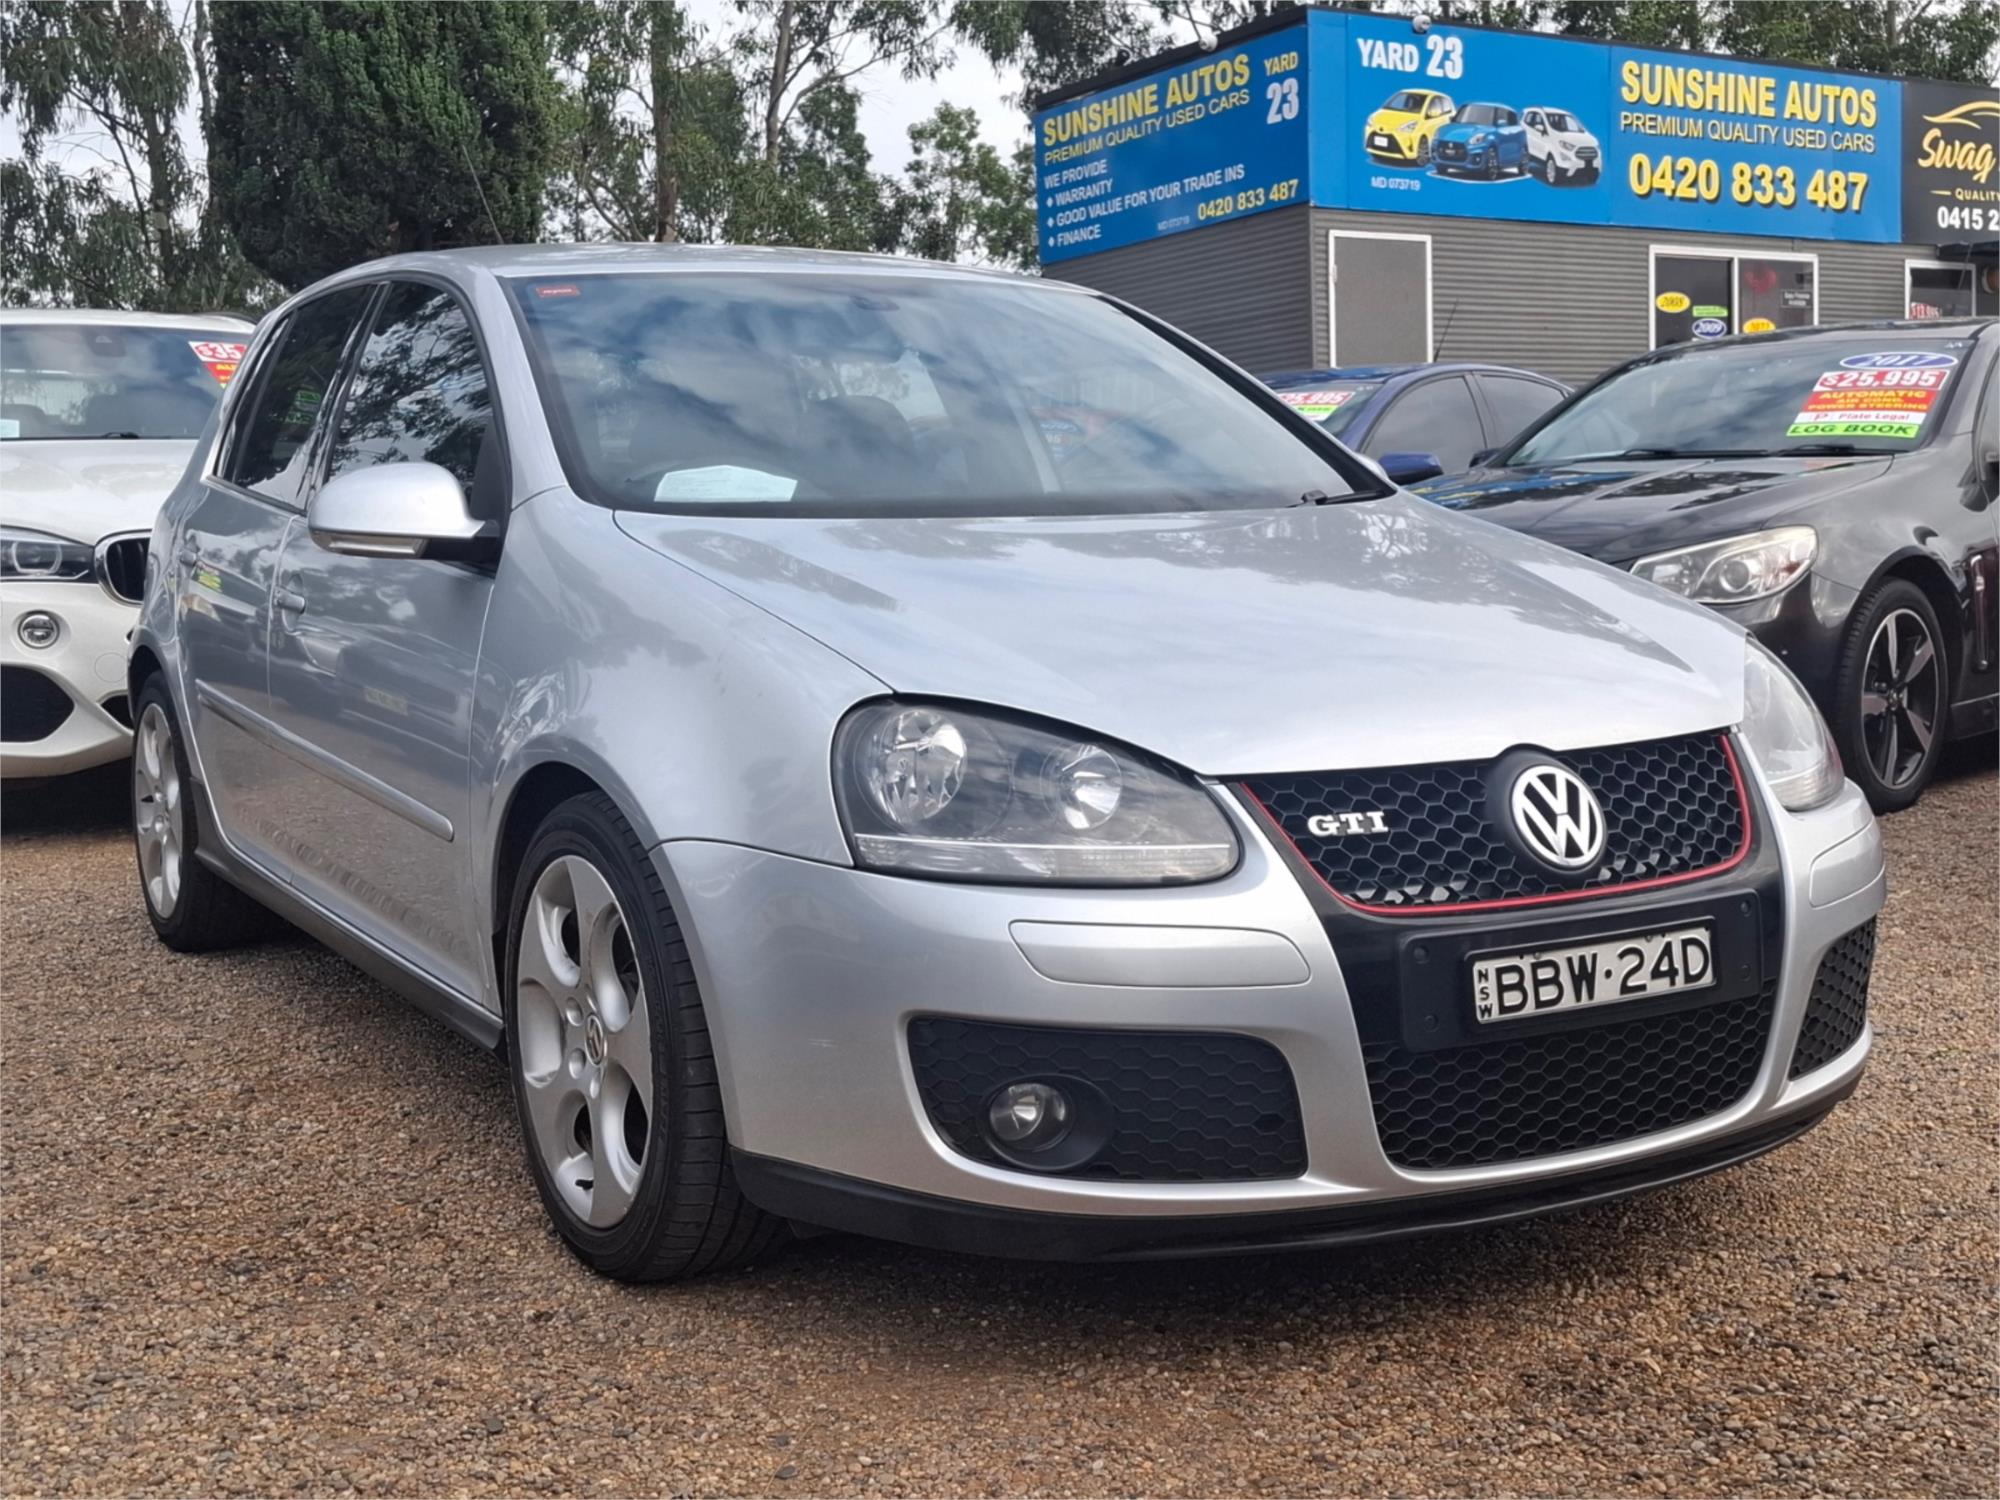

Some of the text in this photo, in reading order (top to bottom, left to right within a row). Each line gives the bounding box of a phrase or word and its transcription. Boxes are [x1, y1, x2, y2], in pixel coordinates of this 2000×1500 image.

[1264, 52, 1298, 76] YARD
[1357, 35, 1464, 79] YARD 23
[1043, 54, 1250, 146] SUNSHINE AUTOS
[1266, 78, 1299, 125] 23
[1621, 60, 1877, 128] SUNSHINE AUTOS
[1044, 89, 1250, 166] PREMIUM QUALITY USED CARS
[1620, 111, 1875, 153] PREMIUM QUALITY USED CARS
[1918, 128, 1996, 184] Swag
[1044, 159, 1107, 189] WE PROVIDE
[1371, 176, 1387, 189] MD
[1629, 153, 1868, 211] 0420 833 487
[1055, 178, 1113, 206] WARRANTY
[1056, 164, 1245, 227] GOOD VALUE FOR YOUR TRADE INS
[1198, 179, 1299, 220] 0420 833 487
[1937, 205, 1983, 231] 0415
[1057, 224, 1101, 247] FINANCE
[1860, 355, 1939, 367] 2017
[1824, 369, 1939, 387] $25,995
[1819, 390, 1927, 399] AUTOMATIC
[1790, 424, 1914, 435] LOG BOOK
[1307, 811, 1389, 837] GTI
